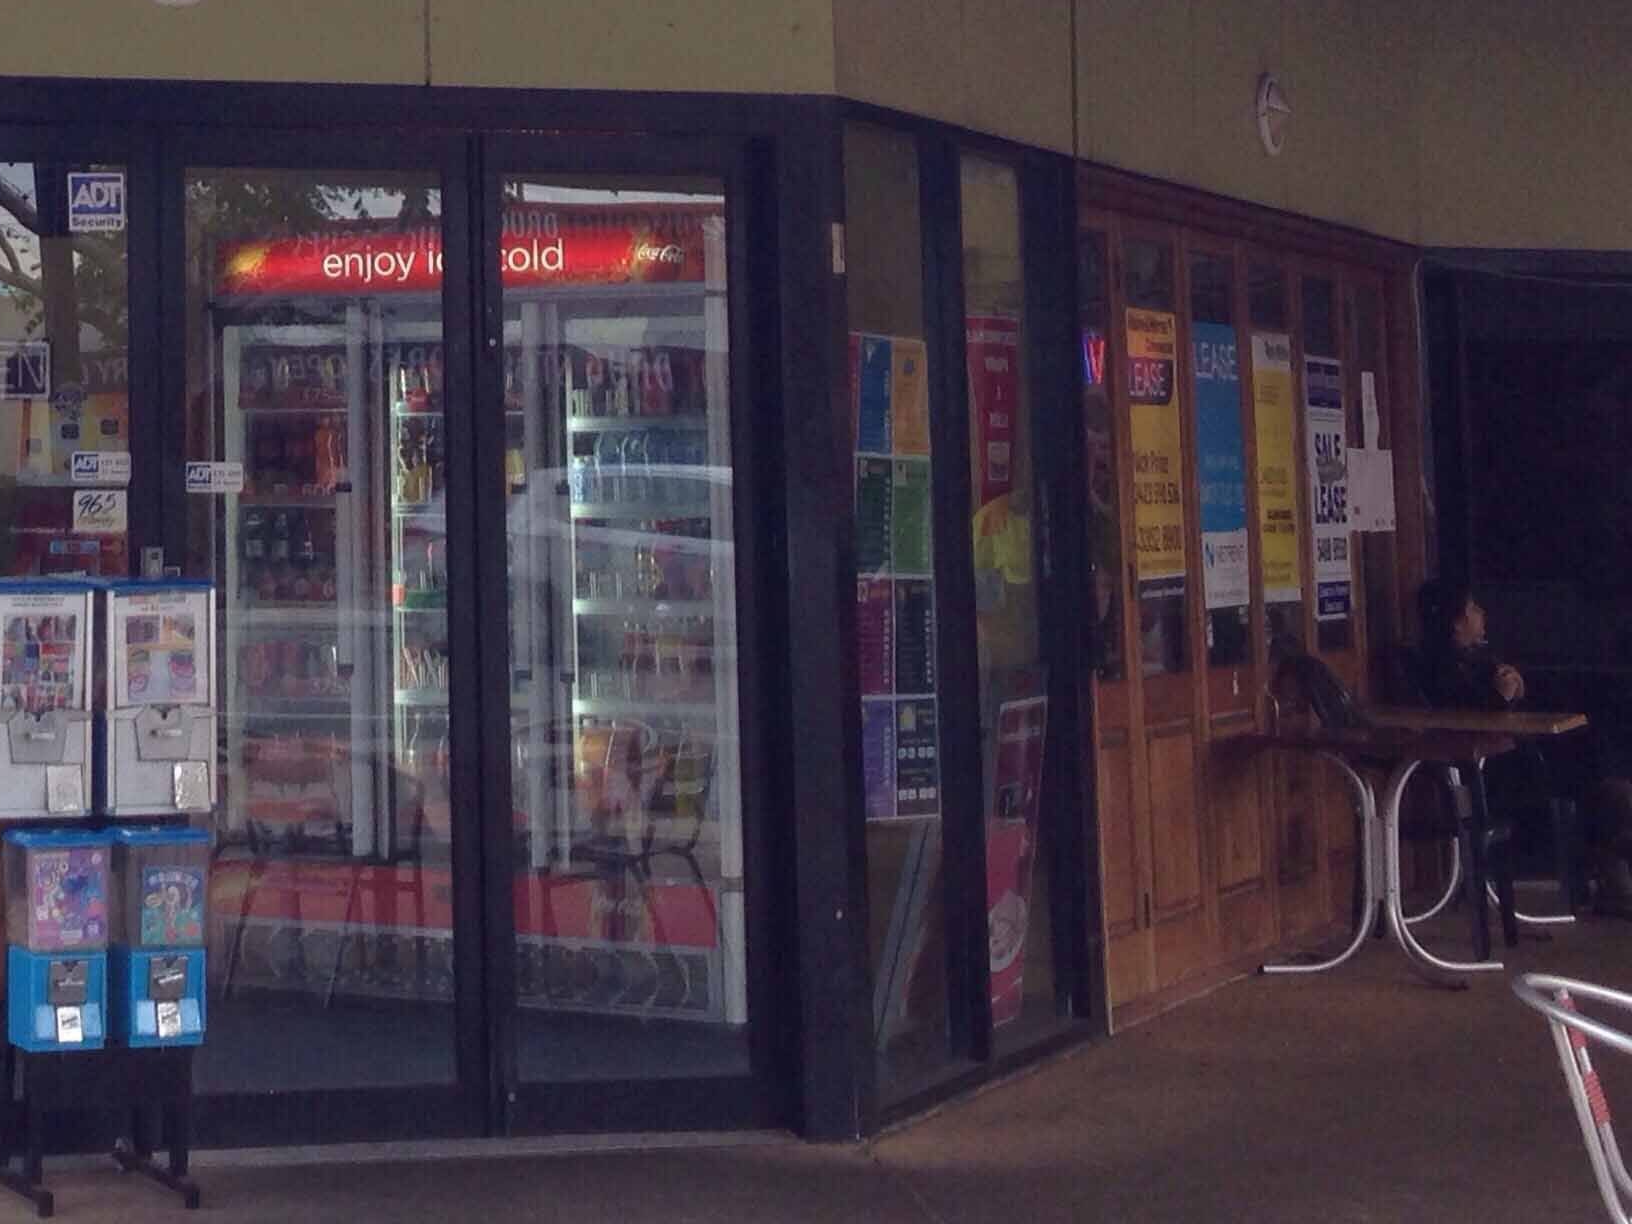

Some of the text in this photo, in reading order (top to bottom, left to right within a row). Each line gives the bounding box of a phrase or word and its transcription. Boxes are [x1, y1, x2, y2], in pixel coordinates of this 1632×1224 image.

[71, 181, 123, 208] ADT
[323, 245, 415, 282] enjoy
[501, 237, 564, 271] old
